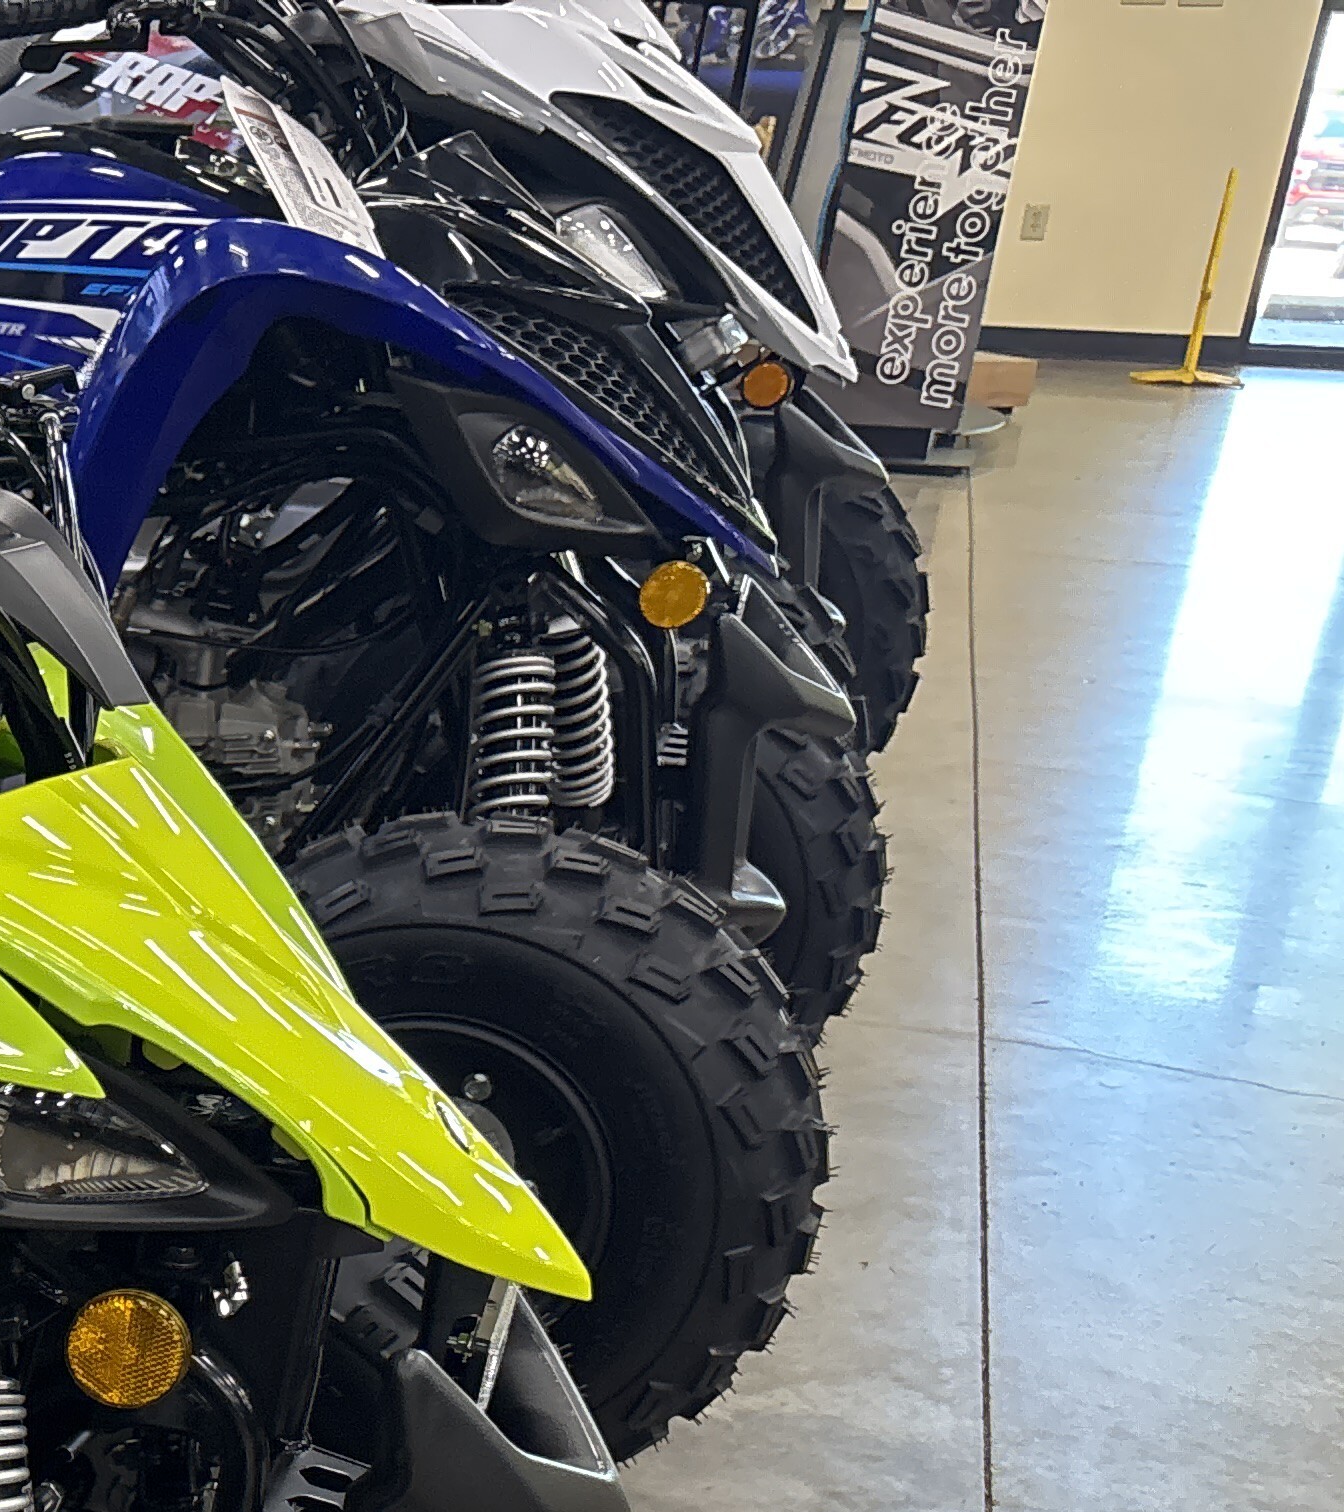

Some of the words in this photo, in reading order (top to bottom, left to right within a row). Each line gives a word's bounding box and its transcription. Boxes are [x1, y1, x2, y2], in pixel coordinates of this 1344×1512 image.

[876, 103, 961, 385] experience
[942, 28, 1028, 262] together
[920, 273, 978, 409] more
